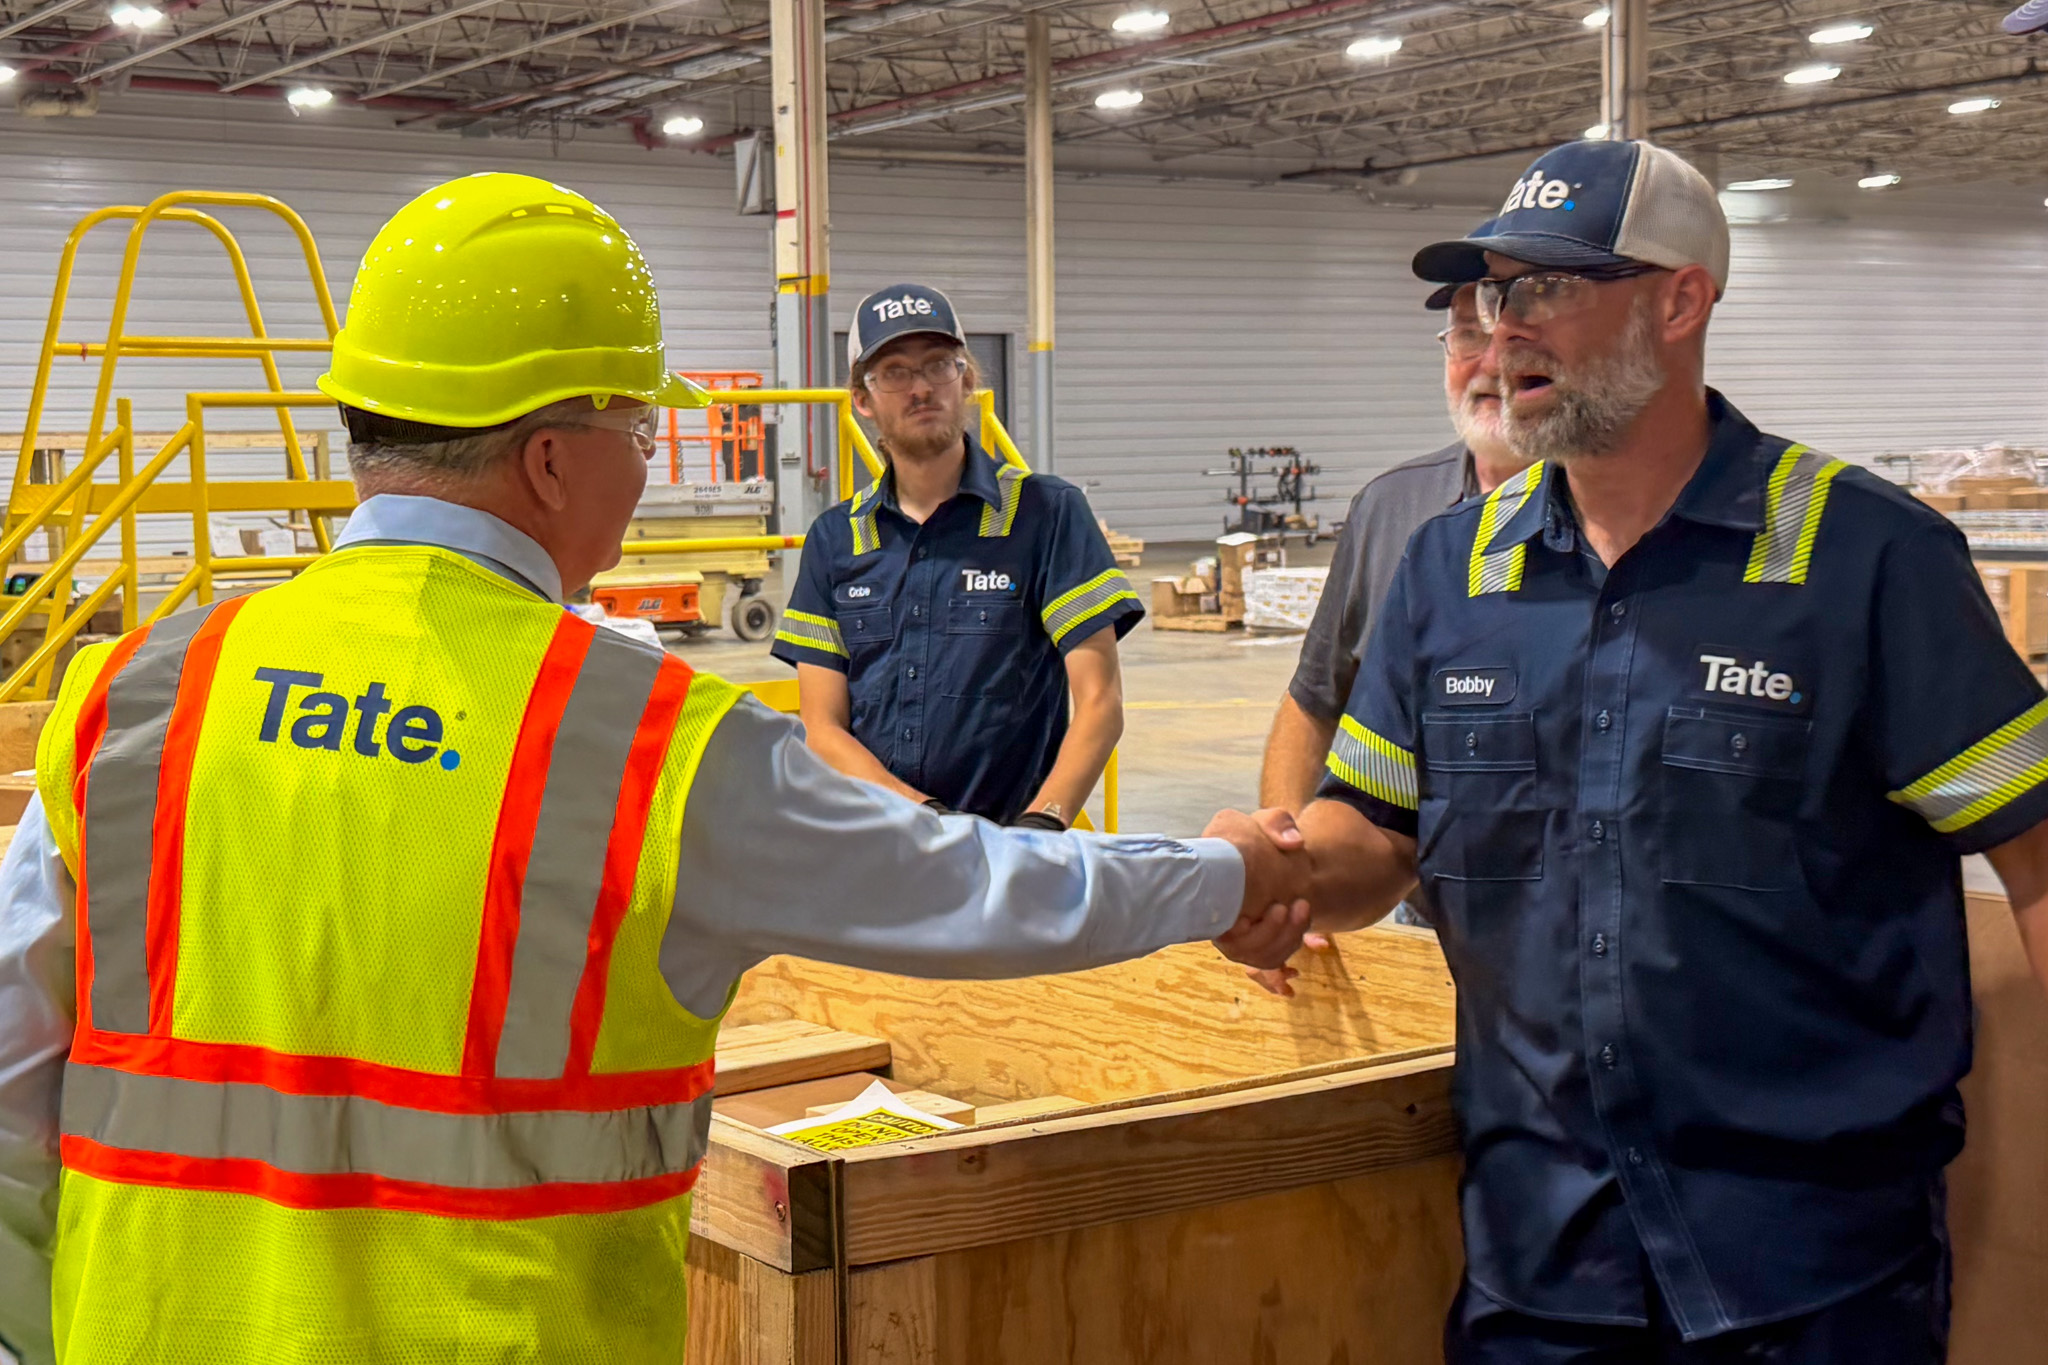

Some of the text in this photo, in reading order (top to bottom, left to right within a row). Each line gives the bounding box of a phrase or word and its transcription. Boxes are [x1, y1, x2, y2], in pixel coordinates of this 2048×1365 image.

[744, 486, 762, 494] JLG
[637, 598, 662, 610] JLG
[1446, 676, 1495, 697] Bobby
[866, 1114, 932, 1134] CAUTIO
[815, 1132, 860, 1145] THIS
